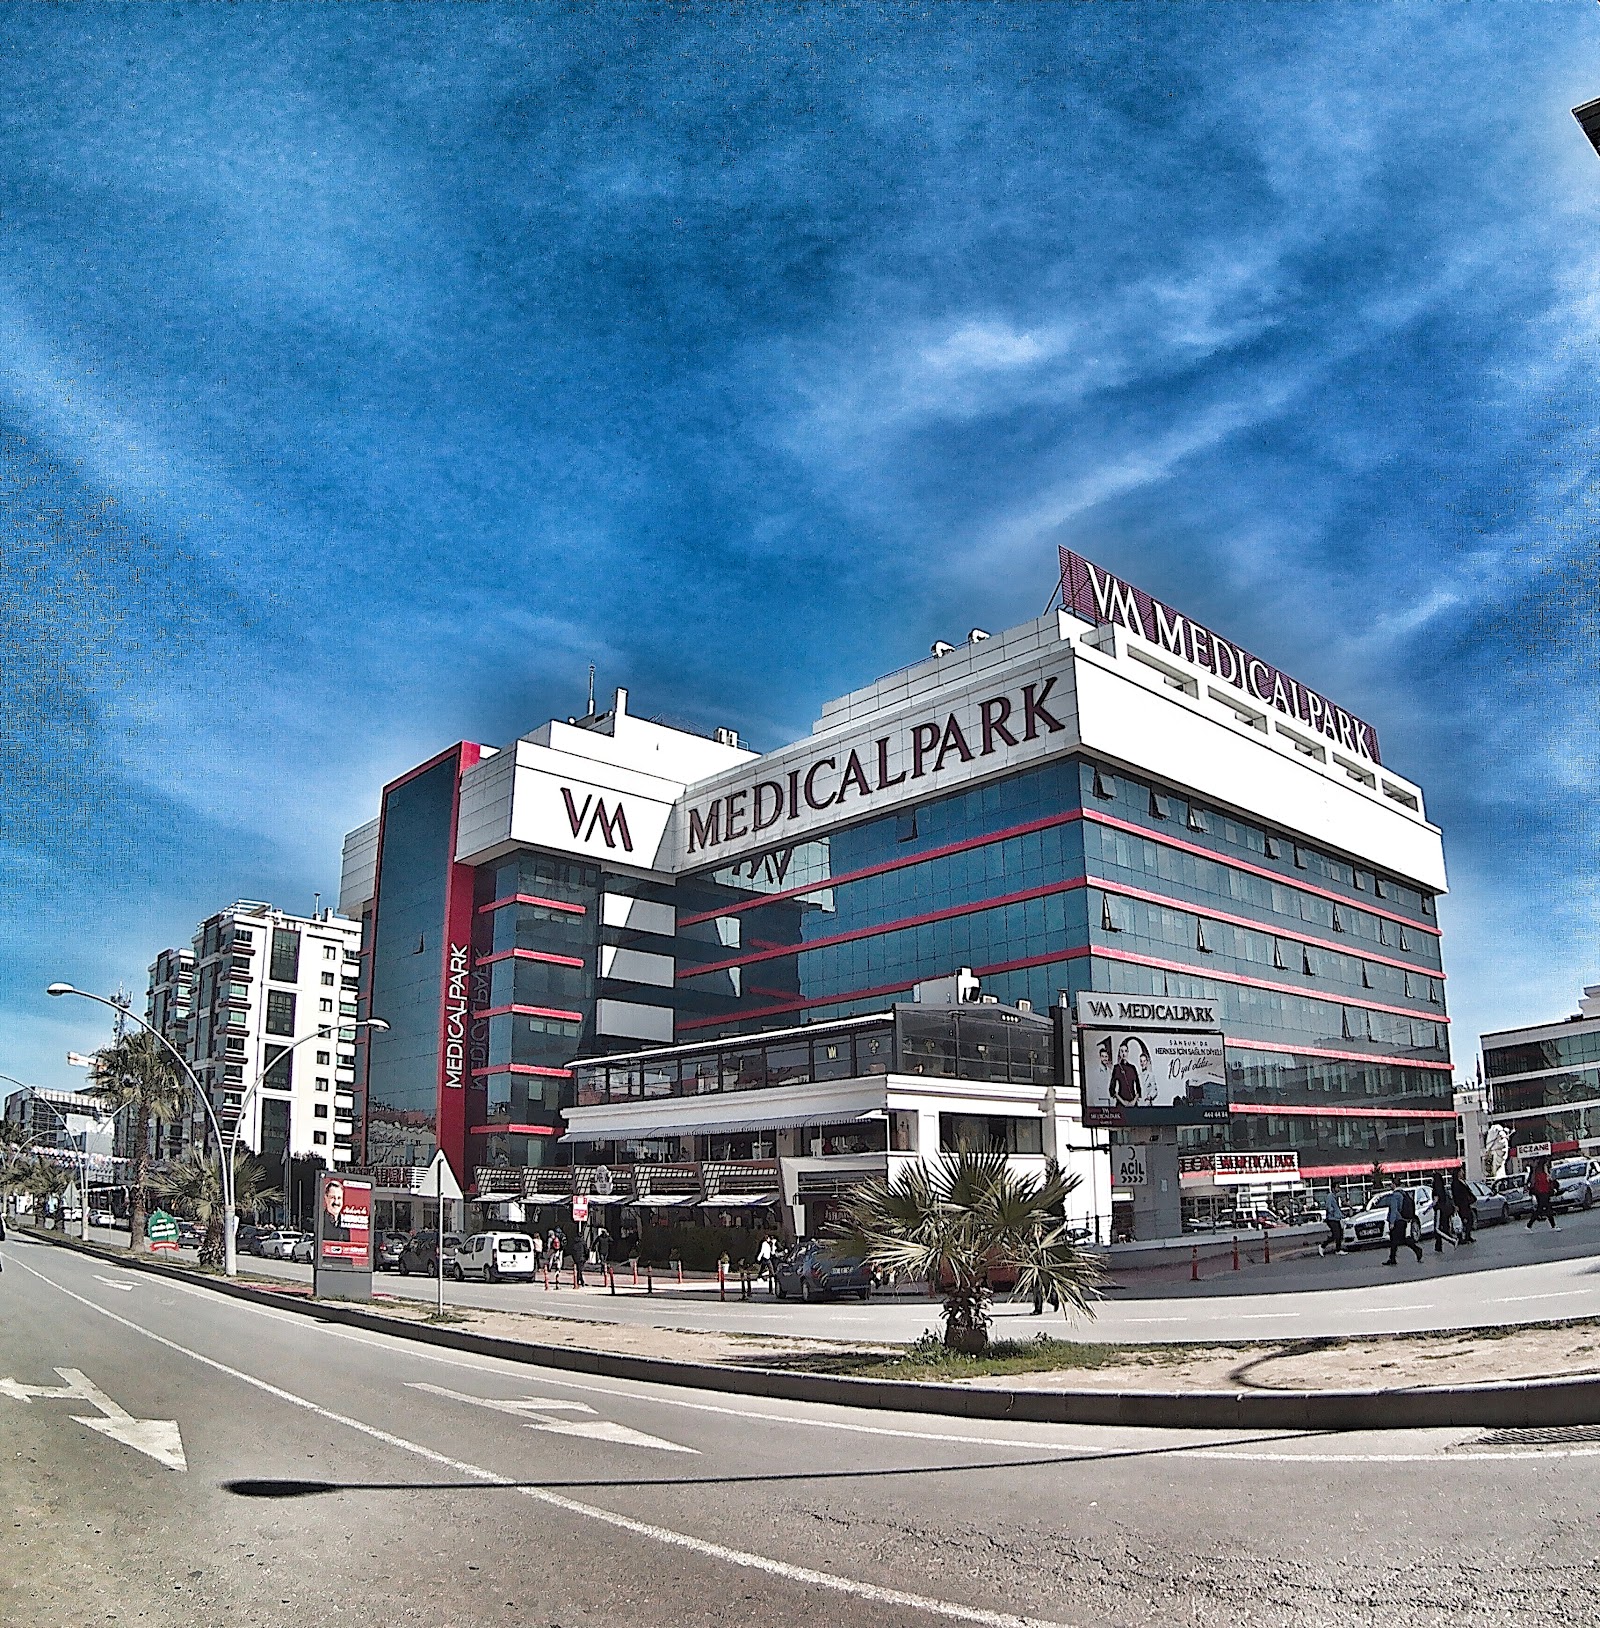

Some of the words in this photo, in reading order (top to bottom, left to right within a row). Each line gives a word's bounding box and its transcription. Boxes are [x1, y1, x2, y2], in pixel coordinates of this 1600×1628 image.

[1085, 561, 1147, 640] VM
[1152, 599, 1374, 762] MEDICALPARK
[686, 676, 1065, 854] MEDICALPARK
[561, 786, 634, 853] VM
[445, 943, 470, 1088] MEDICALPARK
[1087, 1000, 1114, 1019] VM
[1117, 1002, 1215, 1023] MEDICALPARK
[1168, 1057, 1181, 1079] 10
[1120, 1159, 1145, 1175] ACİL
[1519, 1143, 1550, 1154] ECZANE
